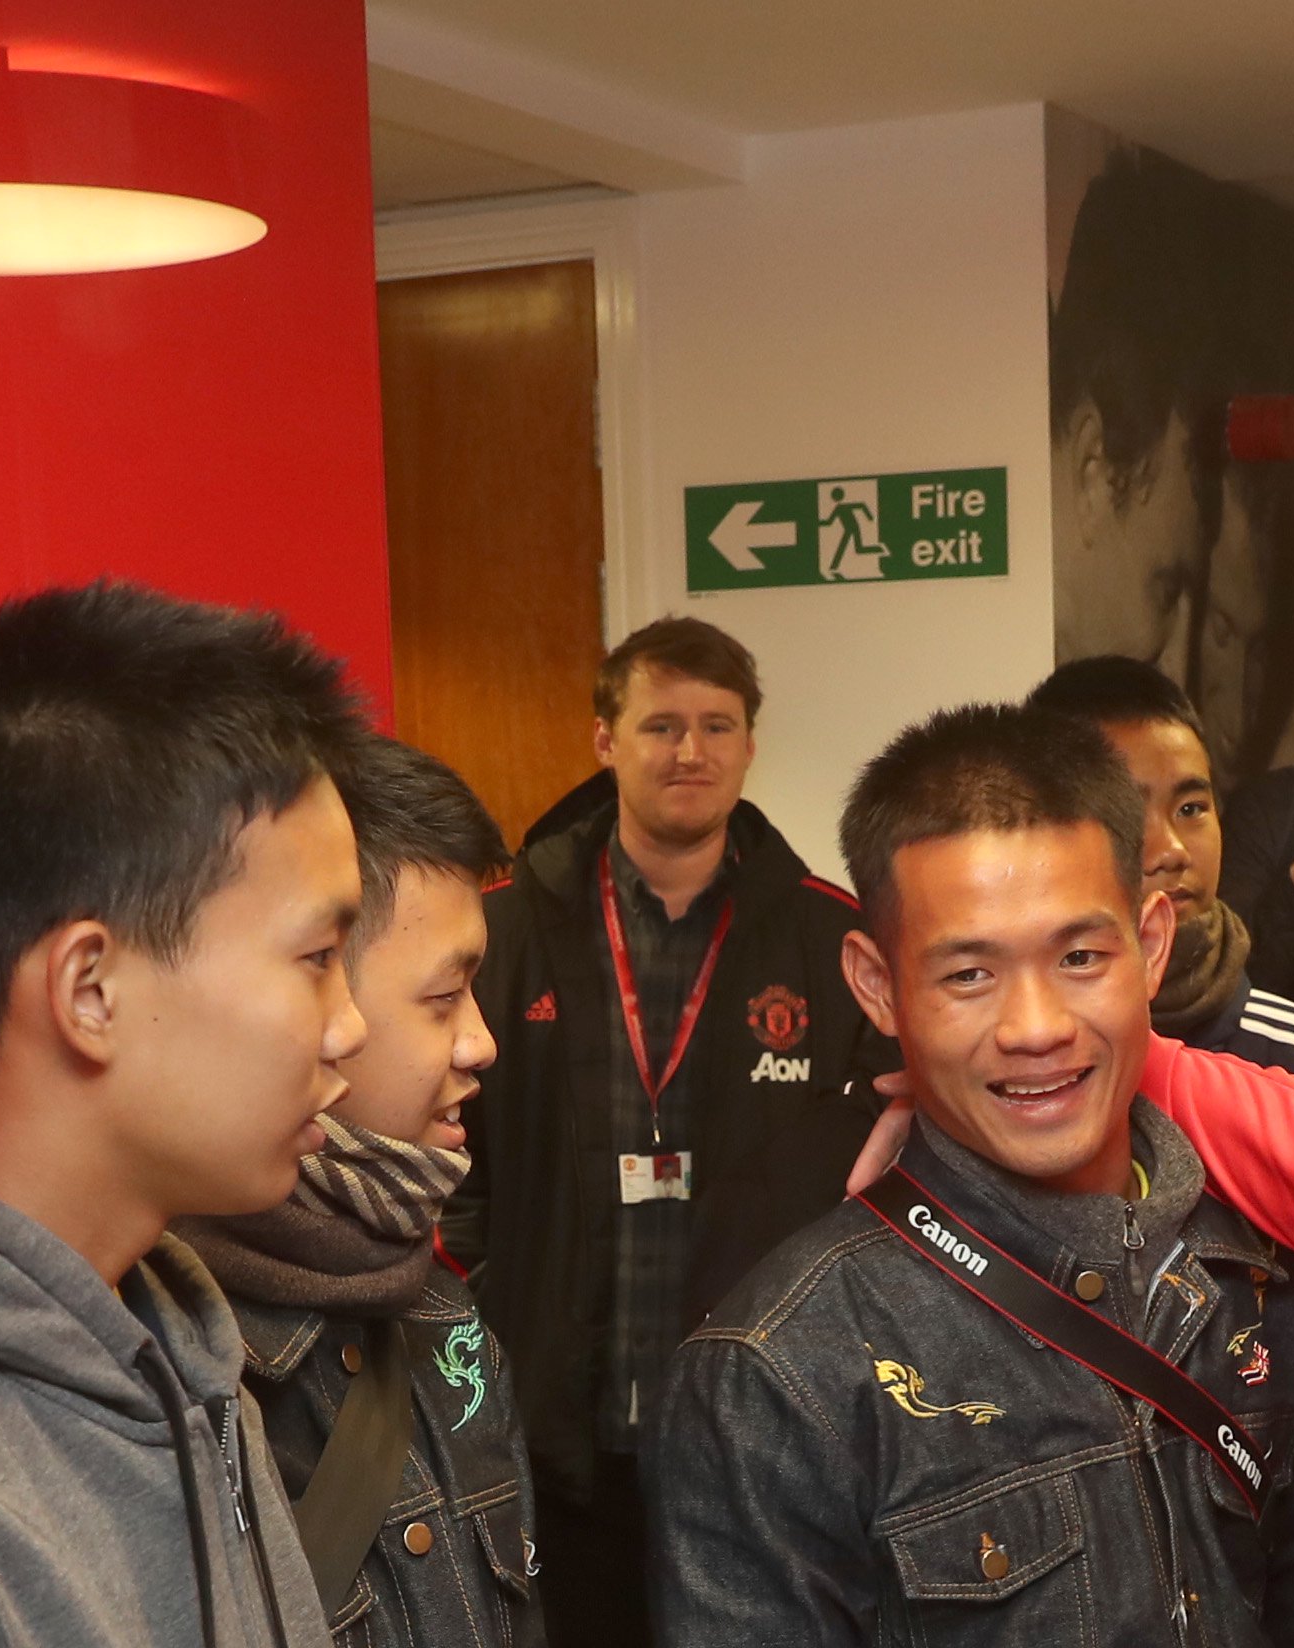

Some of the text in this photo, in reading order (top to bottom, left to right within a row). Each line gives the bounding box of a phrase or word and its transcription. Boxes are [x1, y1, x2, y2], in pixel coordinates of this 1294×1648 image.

[911, 484, 986, 519] Fire
[911, 530, 983, 567] exit
[908, 1204, 988, 1276] Canon
[1217, 1424, 1262, 1490] Canon
